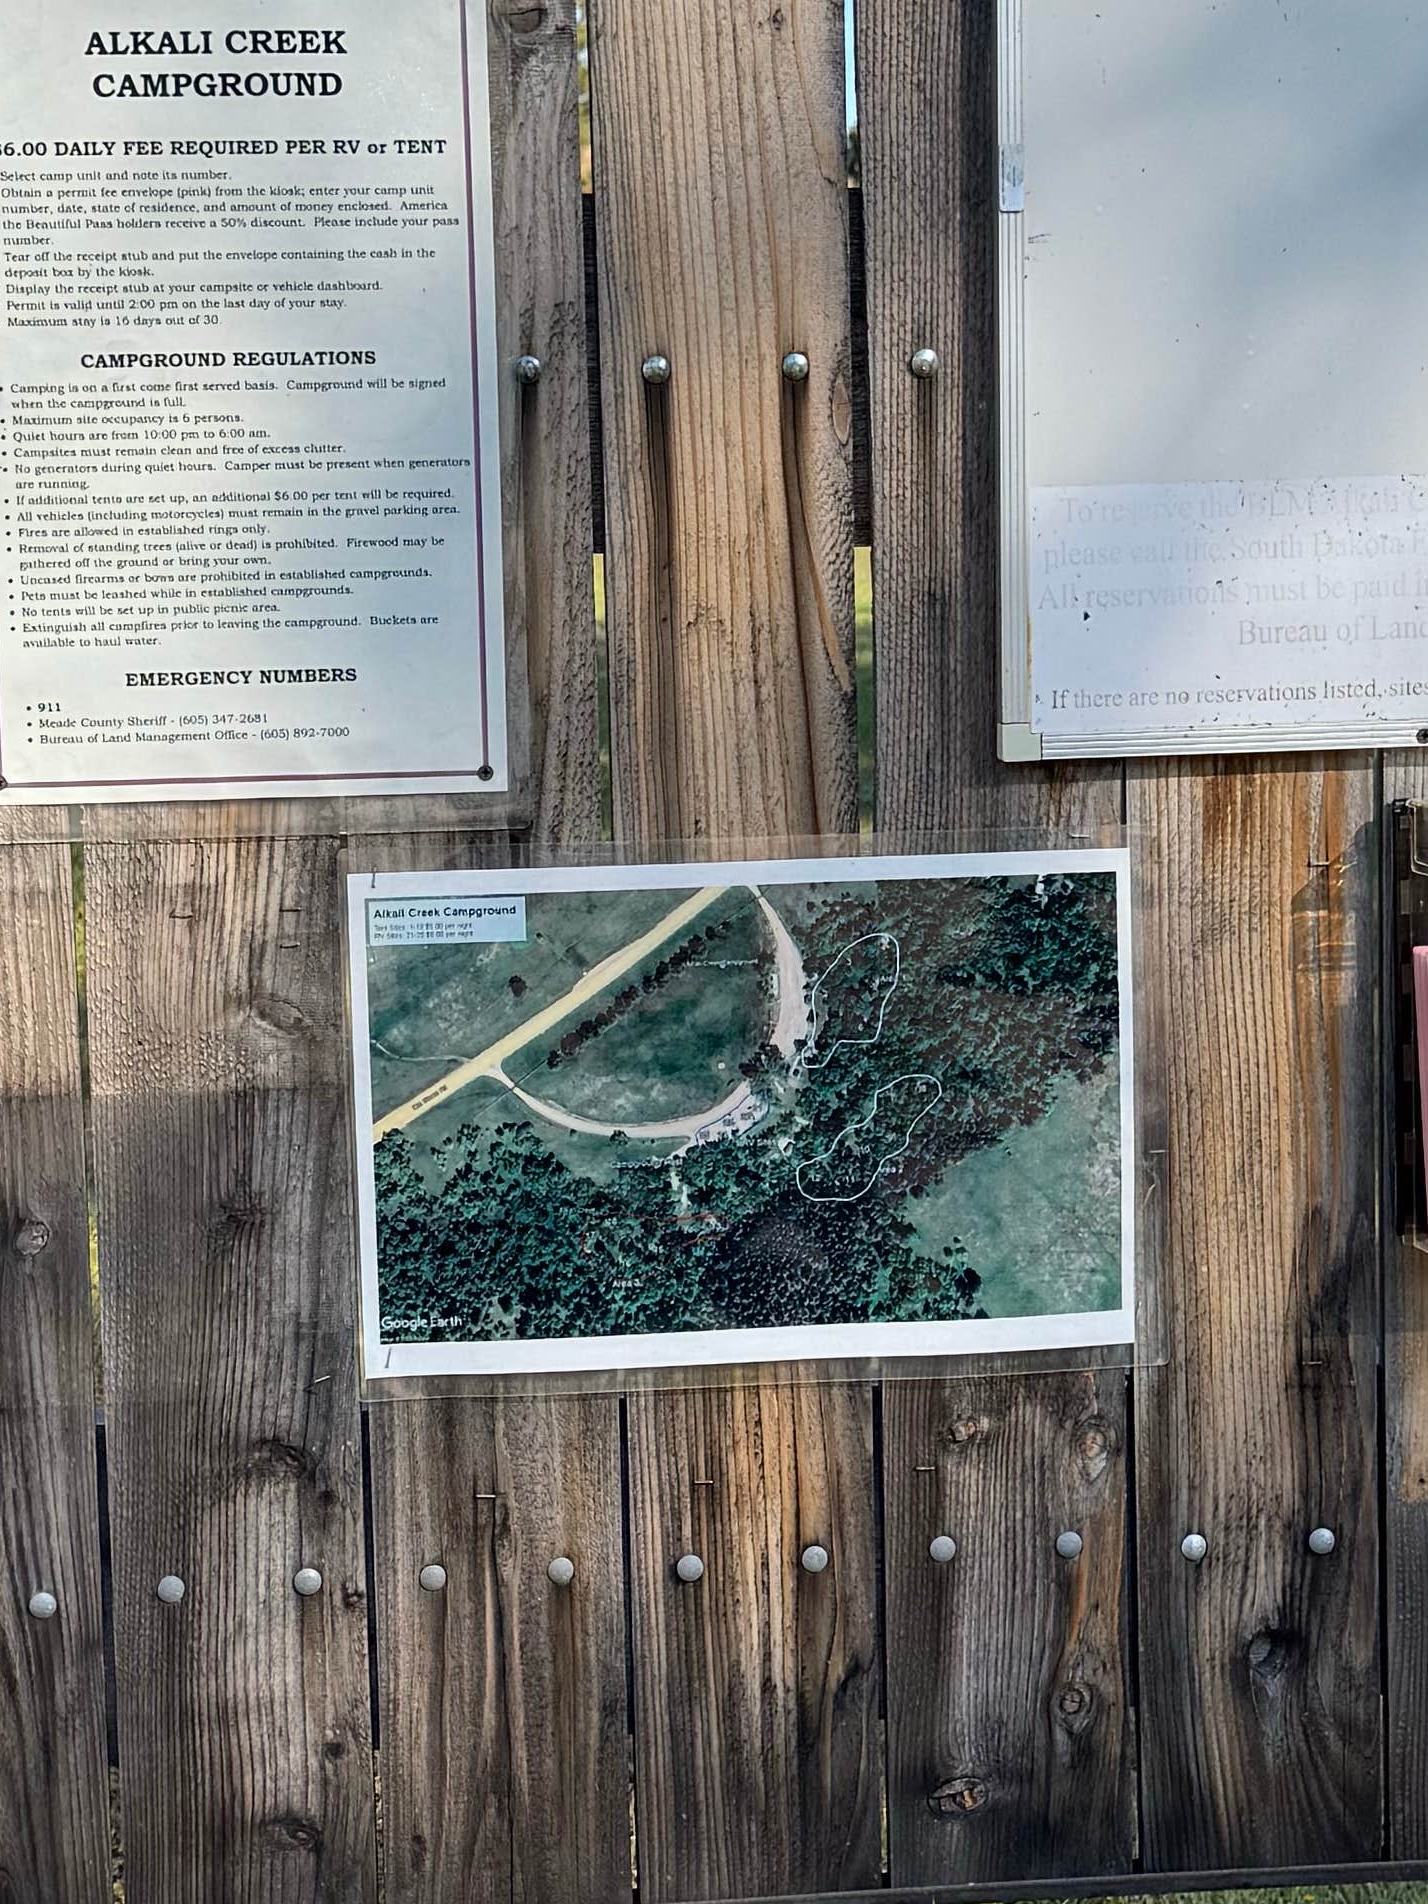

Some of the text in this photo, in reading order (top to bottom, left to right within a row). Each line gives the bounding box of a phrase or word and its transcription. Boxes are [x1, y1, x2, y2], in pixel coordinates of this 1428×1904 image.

[83, 30, 347, 54] ALKALI CREEK
[92, 72, 342, 96] CAMPGROUND
[54, 140, 116, 155] DAILY
[123, 139, 163, 155] FEE
[170, 139, 278, 157] REQUIRED
[285, 138, 326, 154] PER
[333, 138, 360, 153] RV
[367, 141, 386, 153] or
[393, 137, 446, 153] TENT
[0, 168, 231, 184] Select camp unit and note its number.
[1, 185, 41, 197] Obtain
[46, 189, 52, 197] a
[57, 185, 96, 200] permit
[100, 185, 117, 197] fee
[121, 185, 173, 200] envelope
[177, 184, 211, 199] (pink)
[215, 184, 242, 196] from
[247, 184, 265, 196] the
[309, 183, 340, 195] enter
[343, 186, 370, 198] your
[374, 186, 406, 198] camp
[410, 183, 433, 194] unit
[6, 295, 345, 311] Permit is valid until 2:00 pm on the last day of your stay.
[80, 349, 375, 367] CAMPGROUND REGULATIONS
[12, 411, 243, 427] Maximum site occupancy is 6 persons.
[12, 426, 269, 444] Quiet hours are from 10:00 pm to 6:00 am.
[18, 521, 269, 537] Fires are allowed in established rings only.
[1043, 540, 1122, 573] please
[1233, 534, 1303, 559] South
[1085, 579, 1238, 610] reservations
[1315, 574, 1345, 600] be
[1352, 572, 1407, 606] paid
[1238, 619, 1327, 646] Bureau
[1336, 617, 1364, 643] of
[125, 667, 356, 686] EMERGENCY NUMBERS
[1051, 689, 1071, 709] If
[1073, 687, 1123, 708] there
[1128, 690, 1160, 707] are
[1164, 689, 1191, 706] no
[1196, 680, 1317, 703] reservations
[1322, 678, 1384, 700] listed,
[37, 700, 60, 712] 911
[39, 716, 76, 728] Meade
[80, 715, 123, 730] County
[127, 714, 167, 726] Sheriff
[179, 712, 208, 727] (605)
[40, 731, 83, 744] Bureau
[87, 731, 98, 743] of
[102, 730, 130, 742] Land
[135, 728, 210, 744] Management
[214, 727, 247, 739] Office
[260, 726, 289, 741] (605)
[293, 725, 349, 737] 892-7000
[408, 907, 440, 917] Creek
[443, 905, 516, 918] Campground
[381, 1315, 462, 1331] Google Earth
